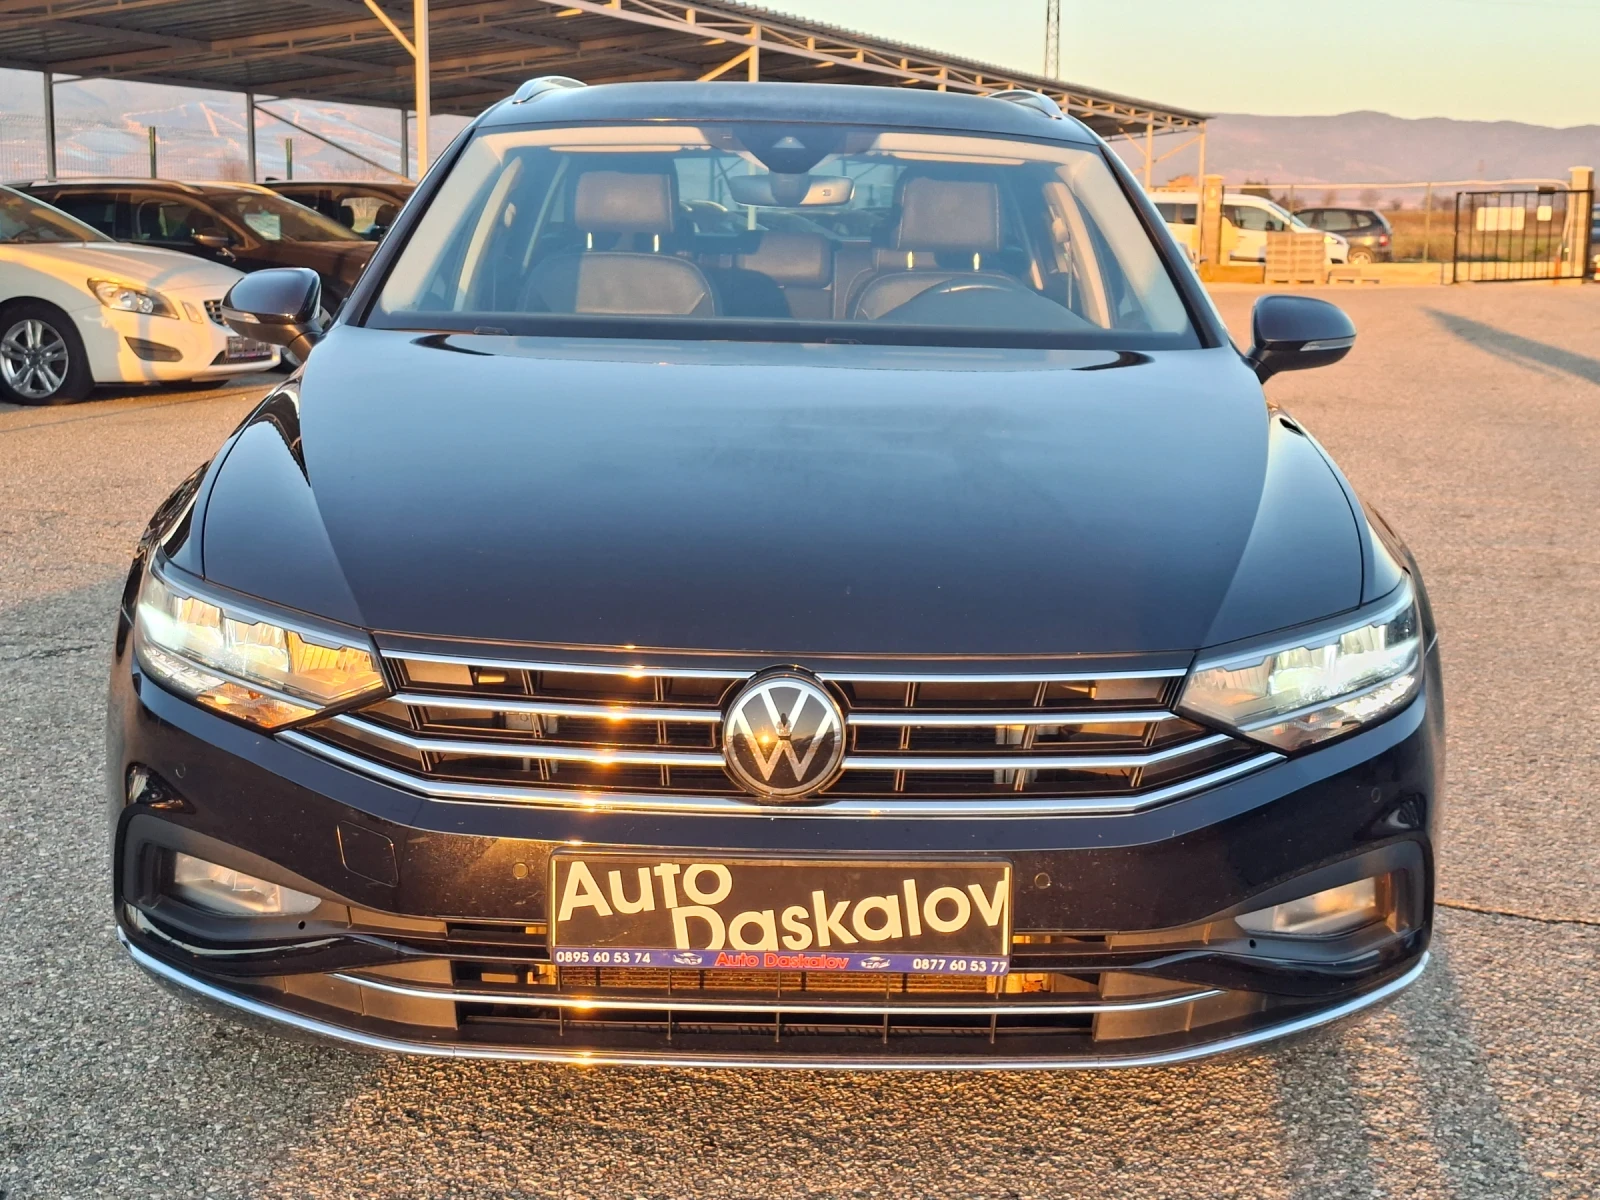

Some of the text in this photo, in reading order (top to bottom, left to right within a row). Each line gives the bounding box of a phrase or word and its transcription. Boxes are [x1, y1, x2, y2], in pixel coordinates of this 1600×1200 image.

[557, 861, 733, 921] Auto
[671, 878, 1009, 951] Daskalov
[556, 951, 1008, 973] 0895 60 53 74 Auto Daskalov 0877 60 53 77
